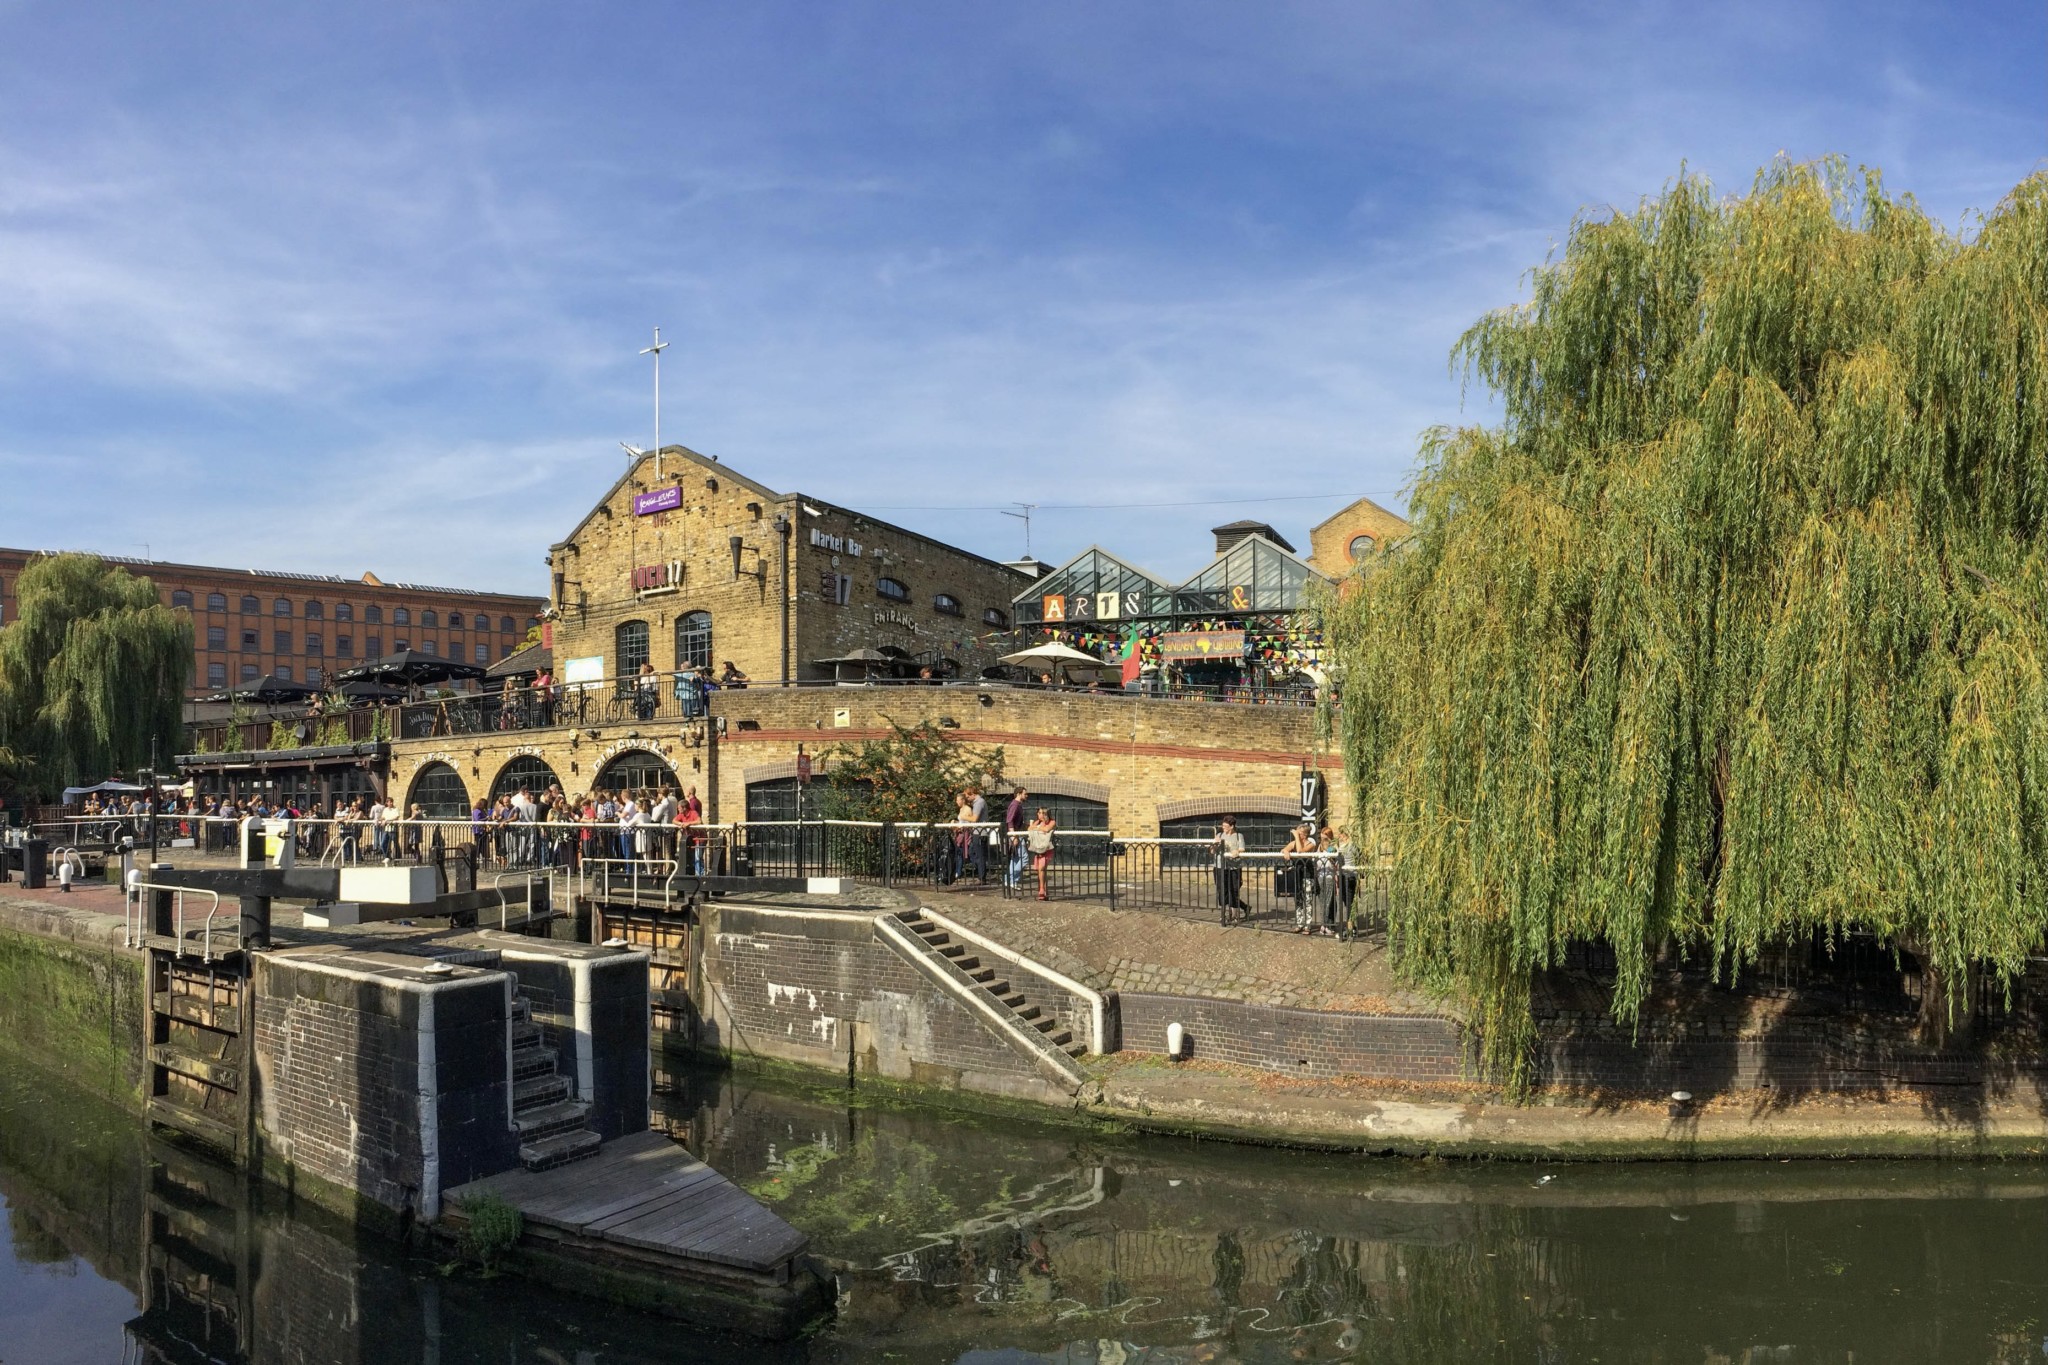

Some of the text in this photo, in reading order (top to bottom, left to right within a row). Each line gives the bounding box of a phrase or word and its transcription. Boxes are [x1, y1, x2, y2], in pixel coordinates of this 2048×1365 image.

[810, 528, 843, 553] Market
[848, 538, 863, 557] Bar
[630, 560, 682, 590] LOCK 17
[835, 573, 853, 605] 17
[1046, 585, 1249, 619] ARTS &
[874, 610, 919, 635] ENTRANCE
[507, 745, 546, 760] LOCK
[593, 738, 680, 772] DINGWALLS
[1301, 778, 1317, 806] 17
